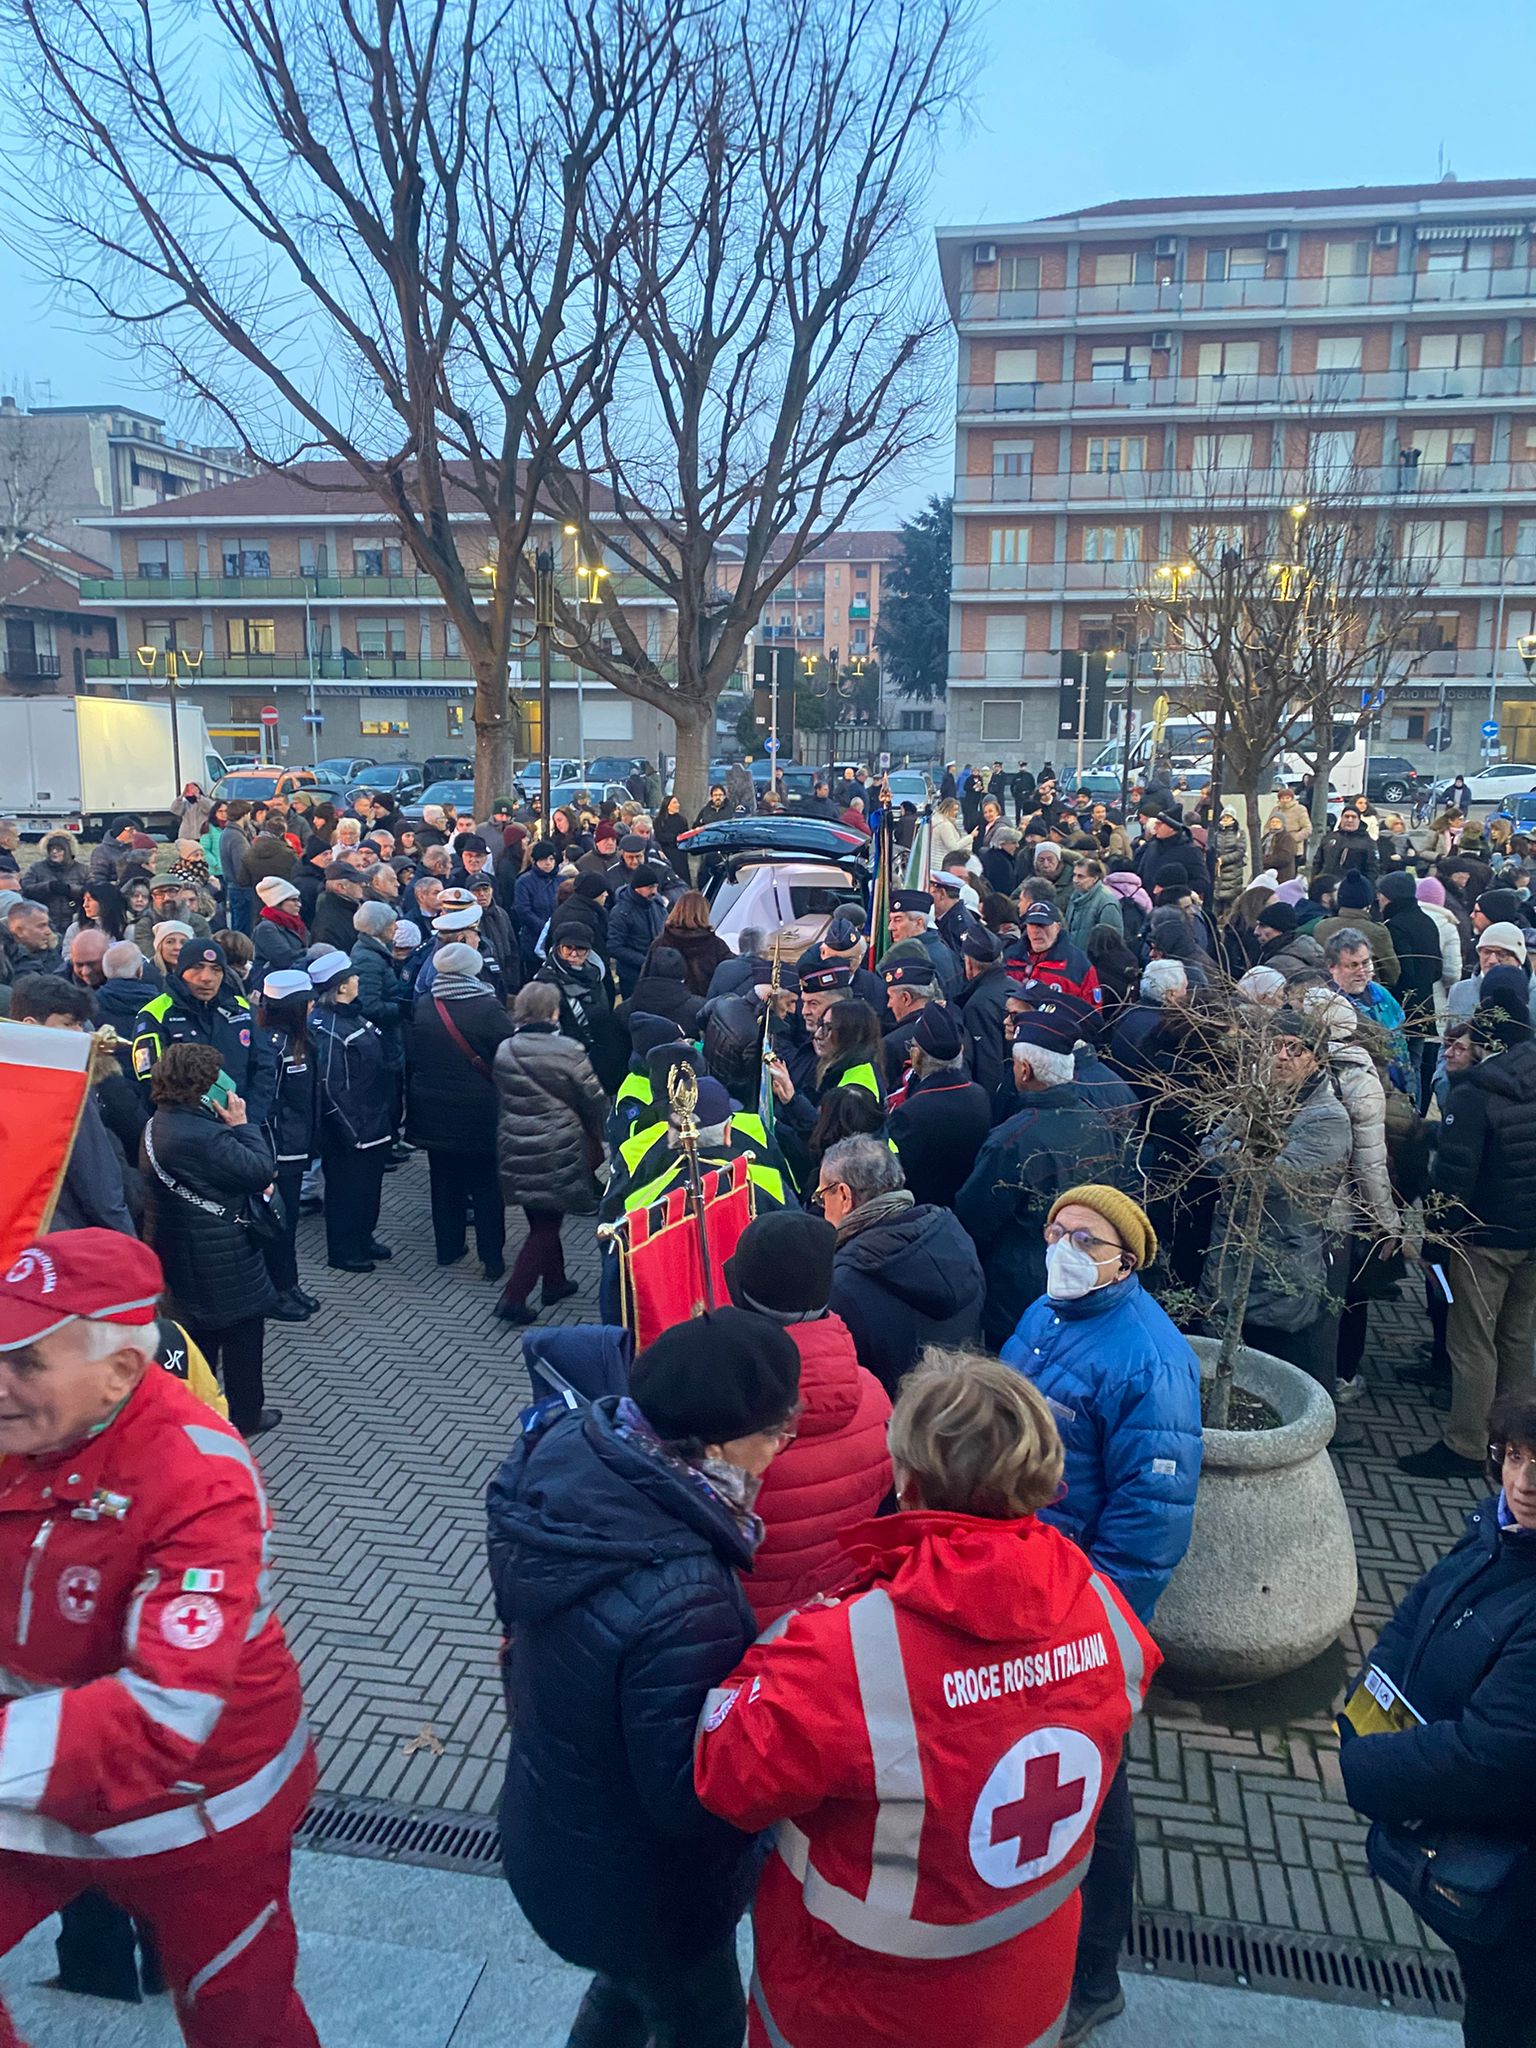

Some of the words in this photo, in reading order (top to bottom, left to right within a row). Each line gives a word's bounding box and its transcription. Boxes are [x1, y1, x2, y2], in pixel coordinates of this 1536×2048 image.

[942, 1663, 1002, 1709] CROCE
[1002, 1650, 1054, 1694] ROSSA
[1052, 1632, 1109, 1681] ITALIANA
